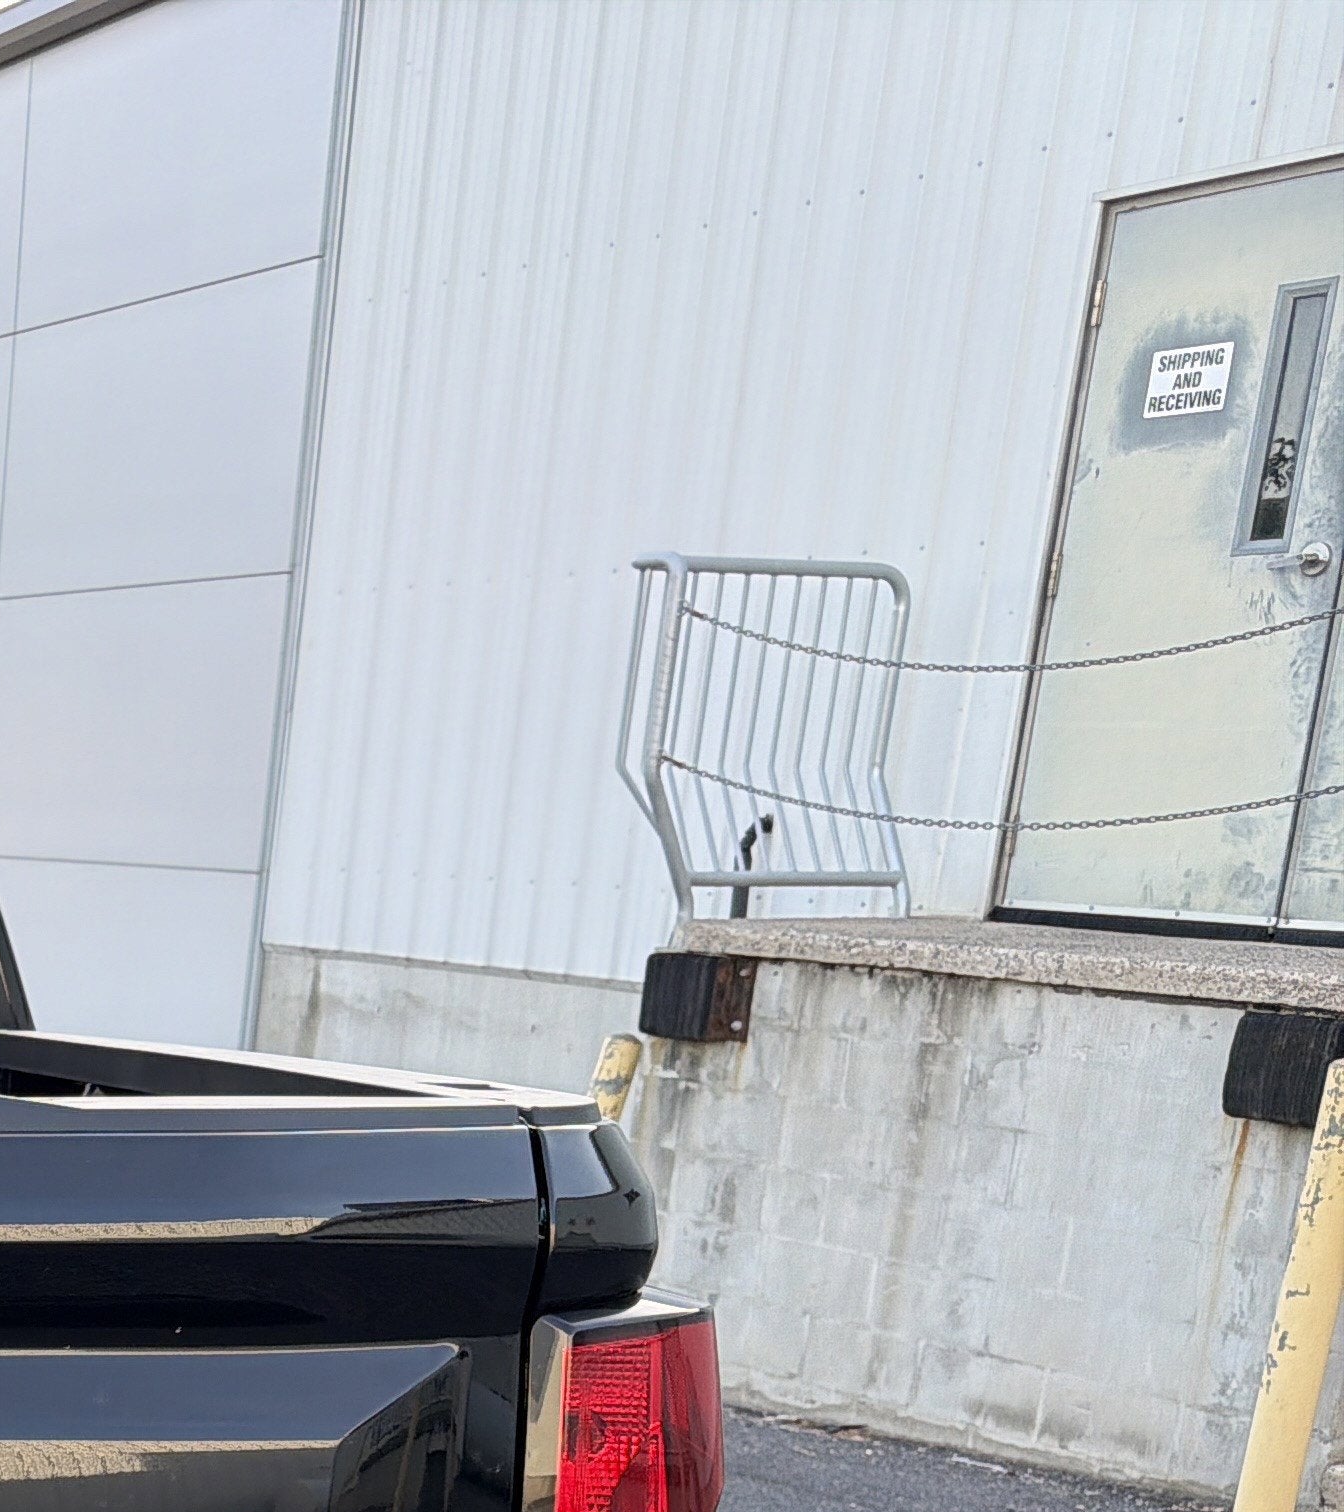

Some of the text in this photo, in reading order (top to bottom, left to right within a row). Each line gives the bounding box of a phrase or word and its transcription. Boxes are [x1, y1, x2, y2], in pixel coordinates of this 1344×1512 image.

[1157, 348, 1225, 373] SHIPPING
[1172, 371, 1202, 390] AND
[1148, 389, 1222, 413] RECEIVING
